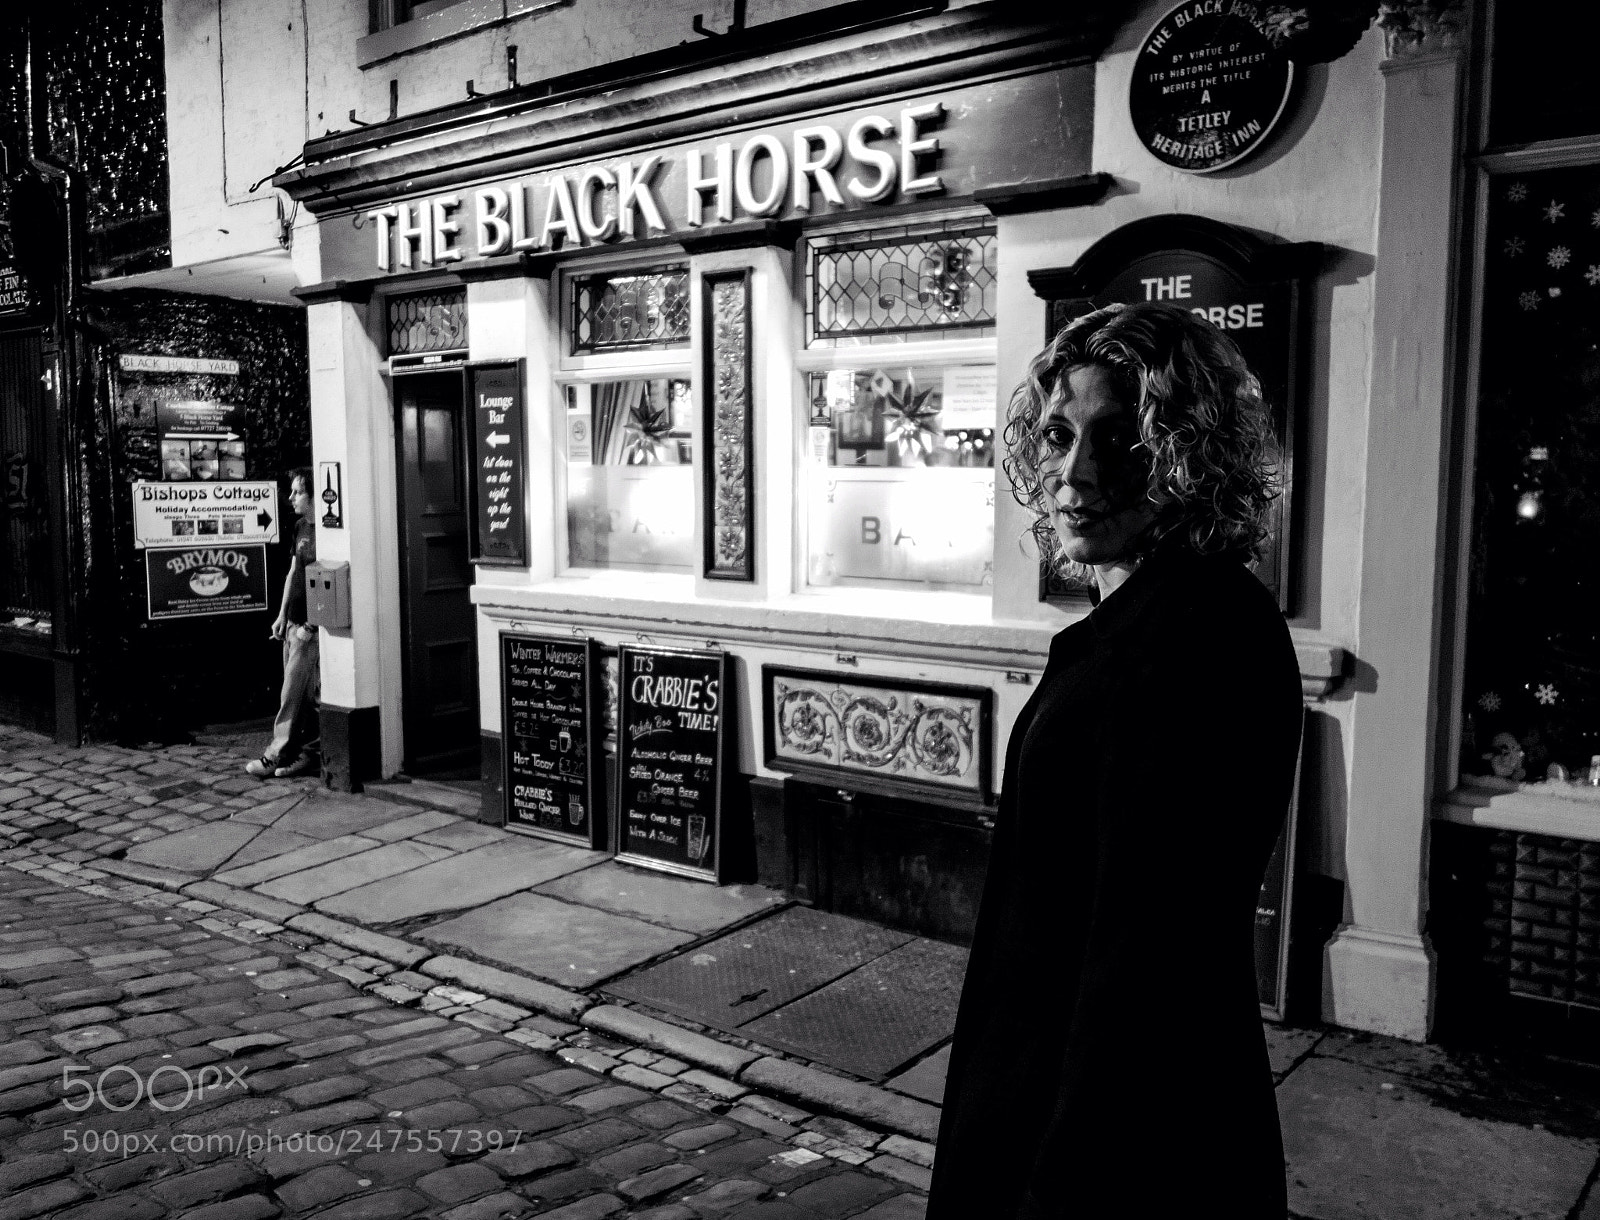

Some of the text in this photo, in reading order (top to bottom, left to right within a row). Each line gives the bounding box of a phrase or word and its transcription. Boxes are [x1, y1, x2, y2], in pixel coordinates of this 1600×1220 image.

[1146, 26, 1172, 55] THE
[1174, 0, 1223, 28] BLACK
[1172, 42, 1241, 64] BY VIRTUE OF
[1150, 52, 1266, 83] ITS HISTORIC INTEREST
[1162, 70, 1252, 95] MERITS THE TITLE
[1200, 89, 1211, 104] A
[1177, 110, 1232, 133] TETLEY
[1151, 119, 1262, 160] HERITAGE INN
[367, 102, 944, 270] THE BLACK HORSE
[1141, 275, 1192, 301] THE
[1190, 303, 1264, 329] RSE
[123, 358, 160, 368] BLACK
[209, 362, 236, 372] YARD
[479, 394, 513, 410] Lounge
[488, 410, 505, 424] Bar
[499, 471, 511, 483] the
[140, 485, 270, 502] Bishops Cottage
[488, 486, 510, 502] right
[155, 505, 258, 514] Holiday Accommodation
[487, 502, 512, 517] up the
[490, 517, 510, 533] yard
[166, 549, 249, 577] BRYMOR
[543, 665, 548, 675] &
[633, 655, 654, 672] IT'S
[632, 675, 718, 711] CRABBIE'S
[678, 711, 719, 731] TIME!
[513, 751, 555, 770] HOT TODDY
[695, 753, 713, 766] BEER
[514, 785, 553, 802] CRABBIE'S
[679, 786, 699, 800] BEER
[649, 829, 656, 839] A
